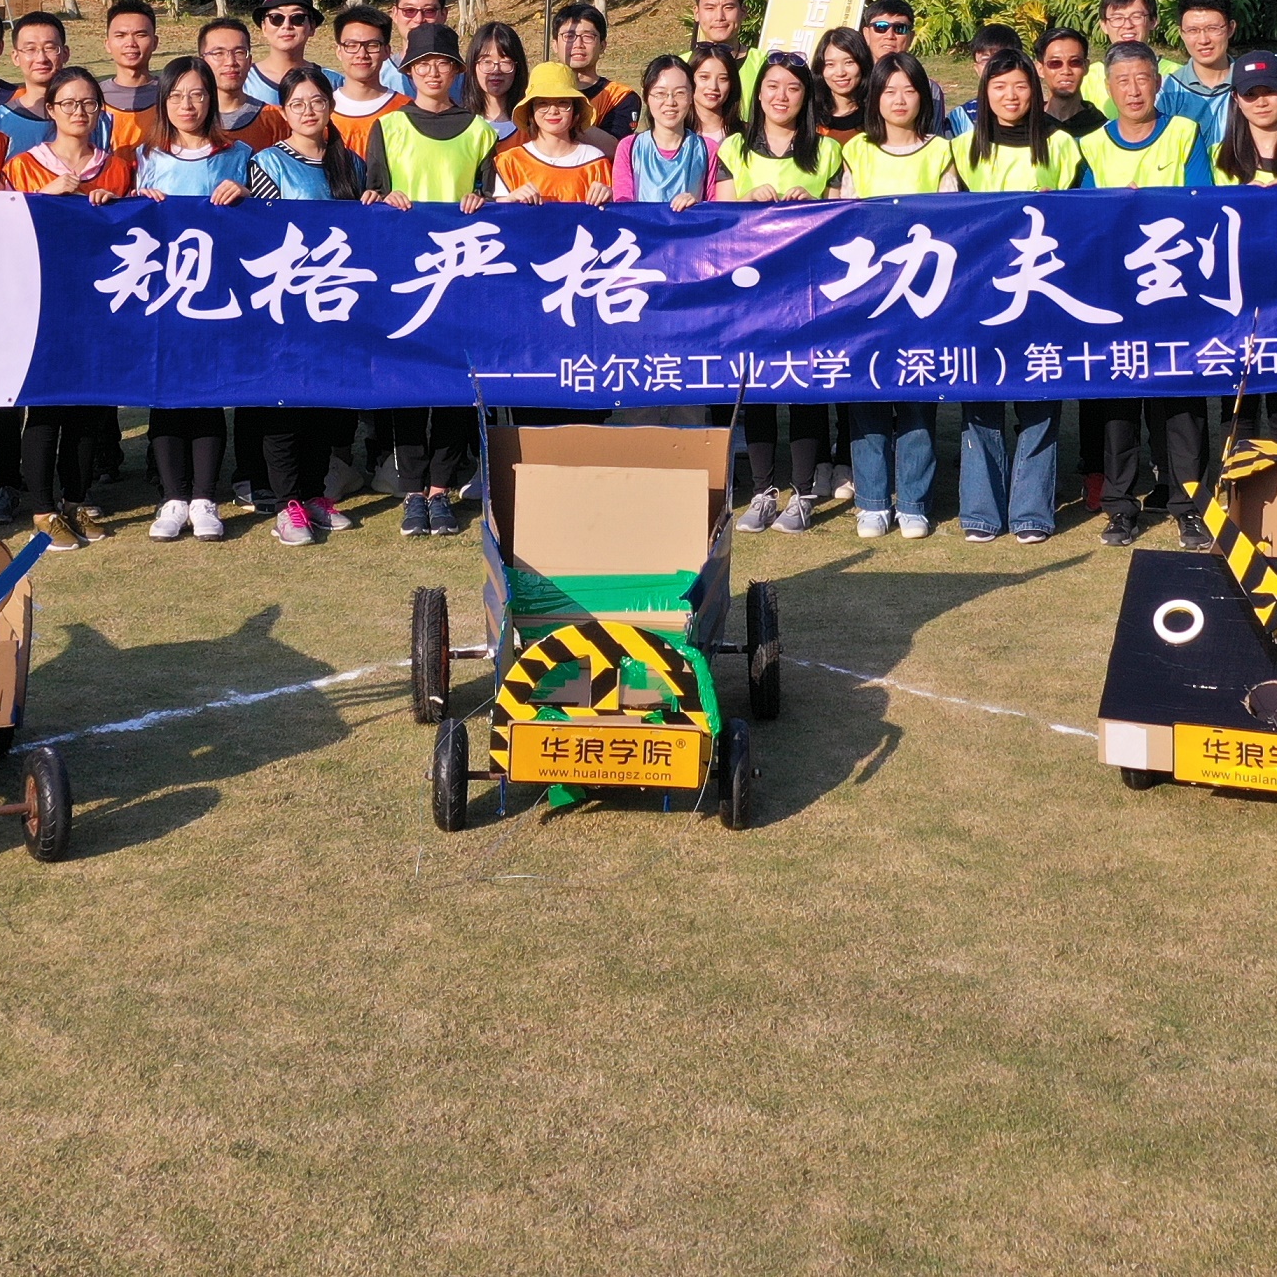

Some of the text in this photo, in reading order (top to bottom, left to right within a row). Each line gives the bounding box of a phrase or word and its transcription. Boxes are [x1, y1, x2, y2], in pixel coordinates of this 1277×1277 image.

[540, 736, 673, 767] 华狼学院
[538, 768, 672, 782] www.hualangsz.com
